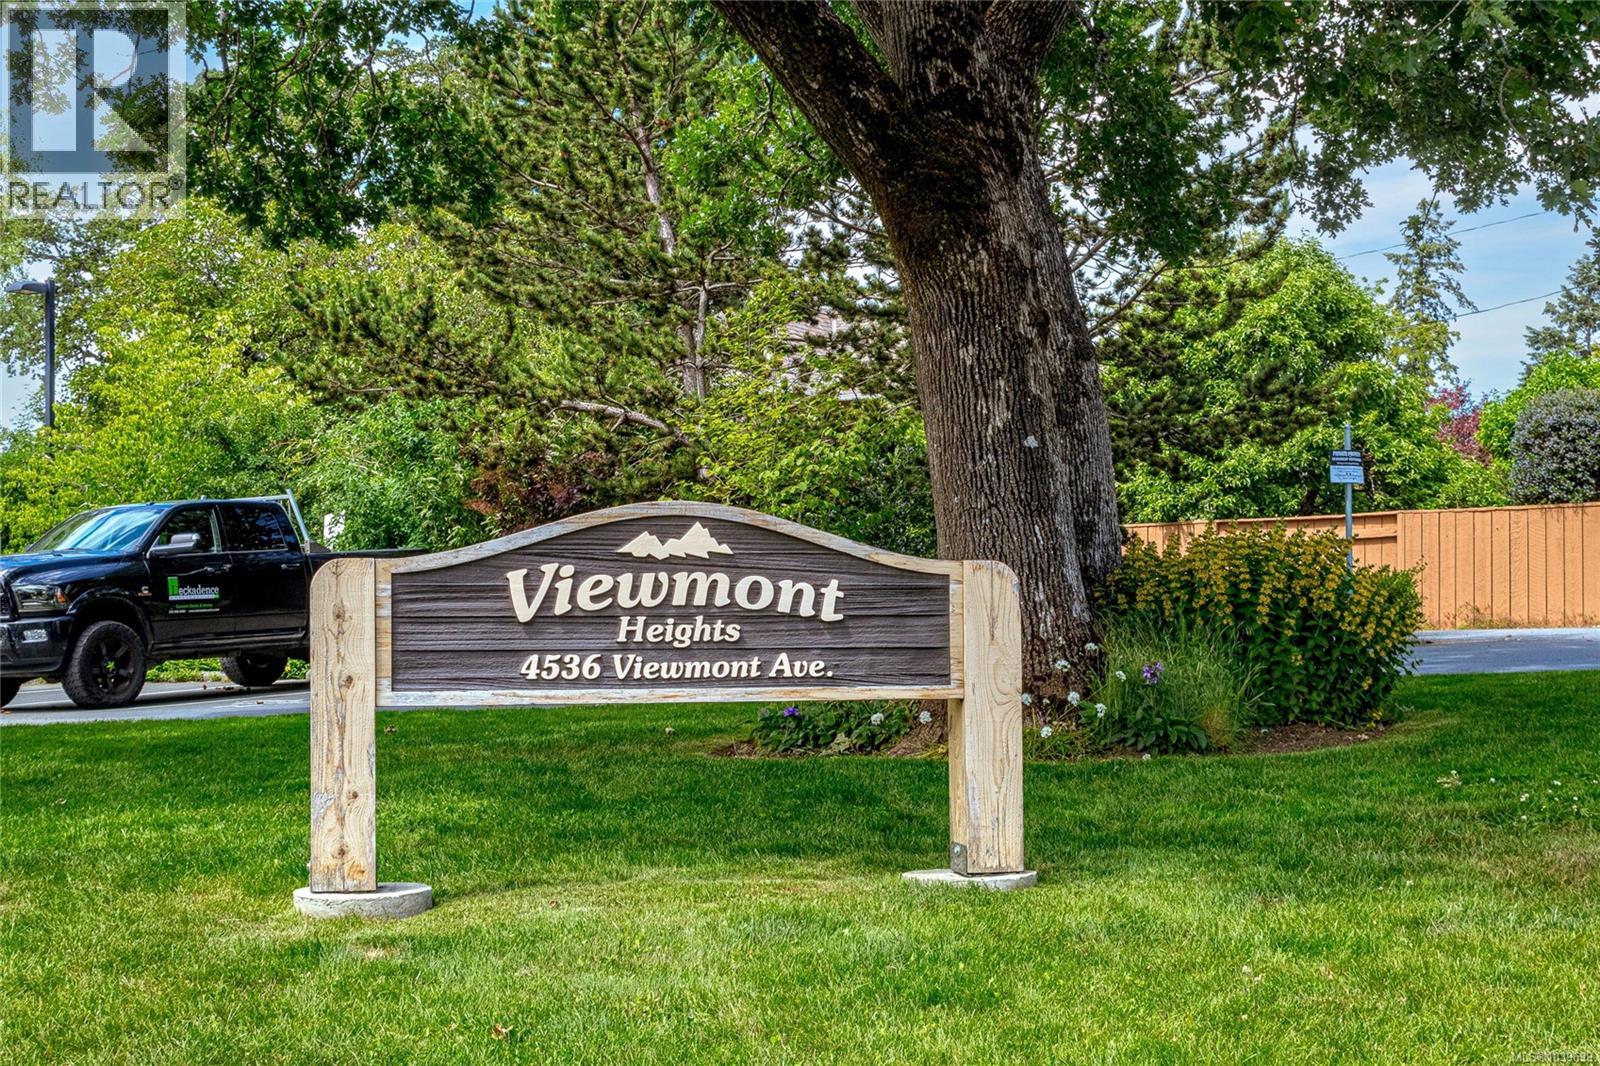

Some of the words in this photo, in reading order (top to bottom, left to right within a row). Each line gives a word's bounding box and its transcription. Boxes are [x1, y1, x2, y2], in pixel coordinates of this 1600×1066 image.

[506, 562, 845, 623] Viewmont
[616, 615, 742, 648] Heights
[520, 653, 601, 680] 4536
[612, 654, 762, 680] Viewmont
[768, 652, 834, 679] Ave.
